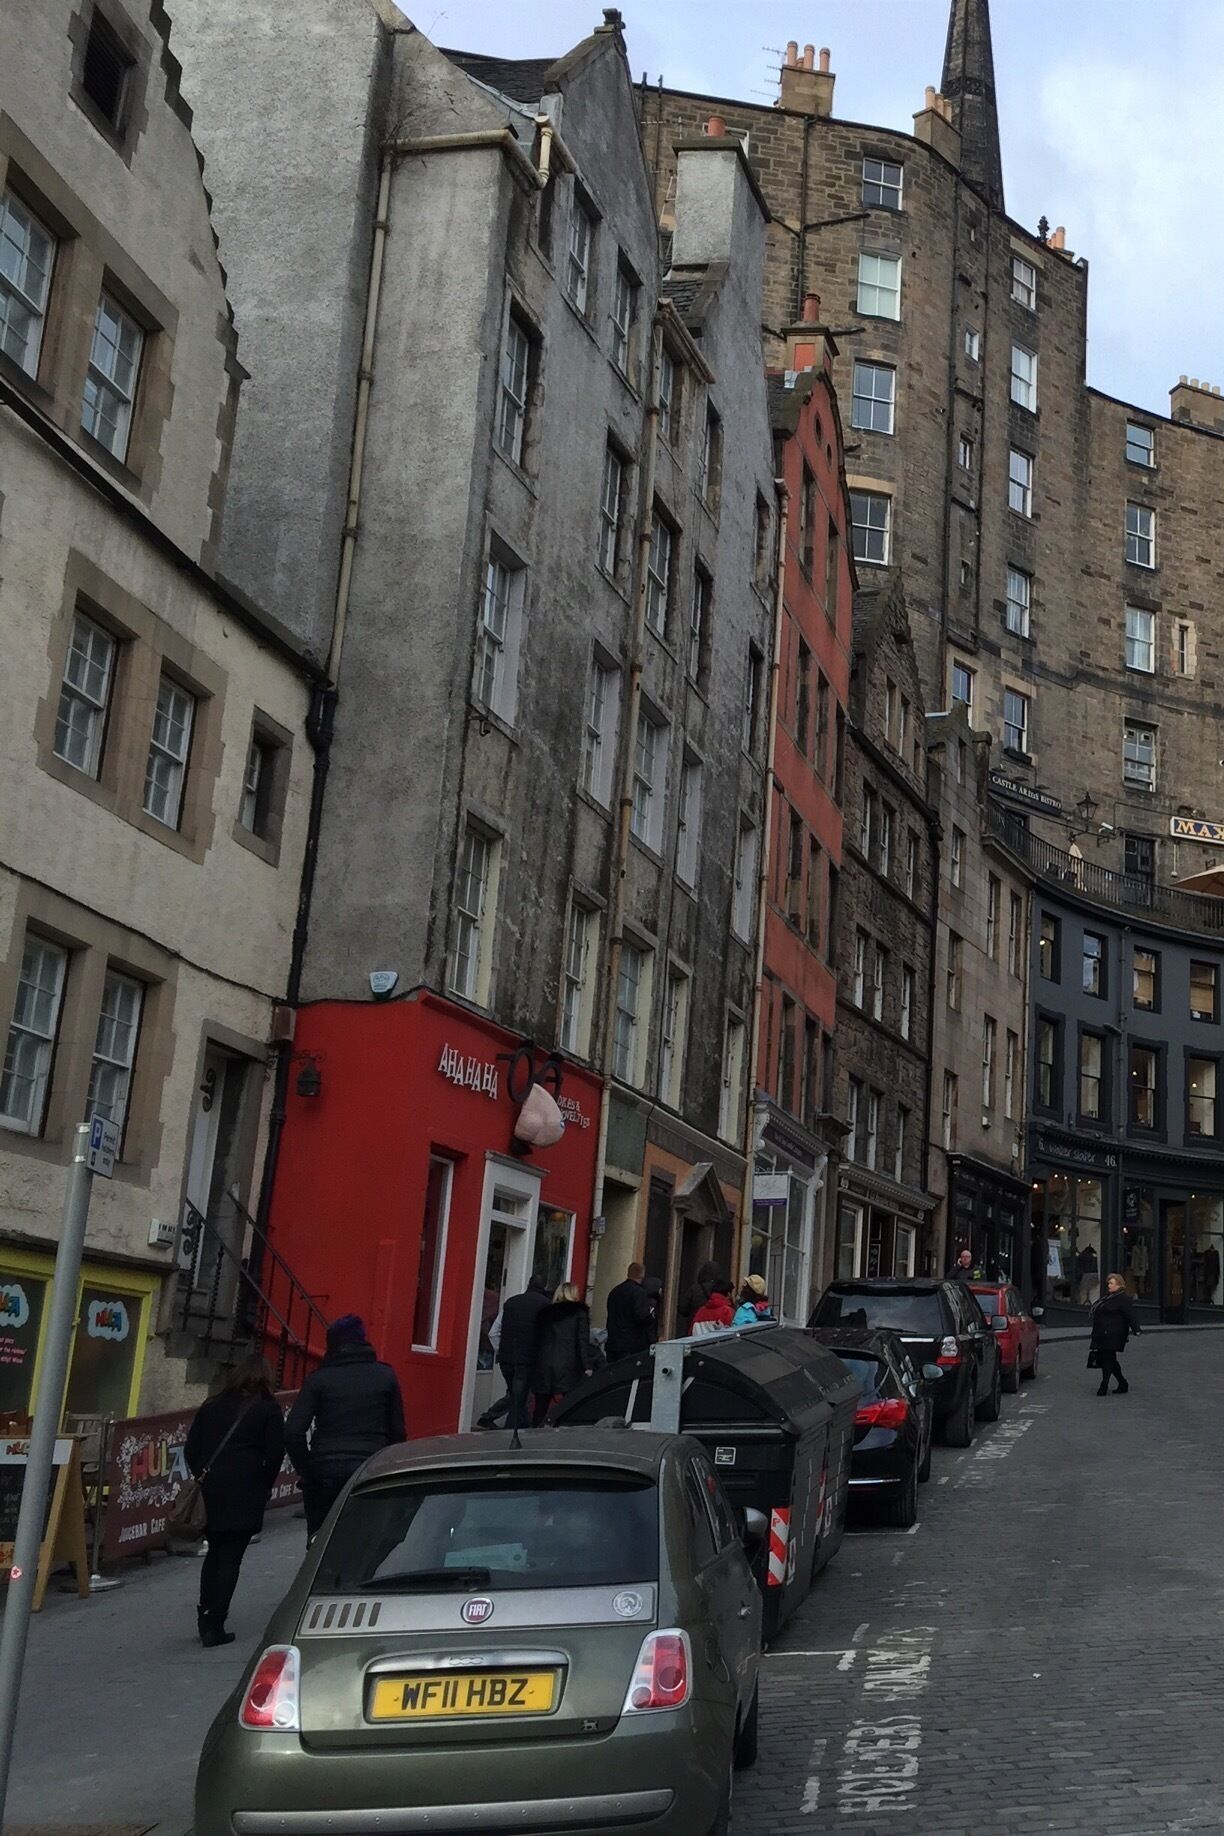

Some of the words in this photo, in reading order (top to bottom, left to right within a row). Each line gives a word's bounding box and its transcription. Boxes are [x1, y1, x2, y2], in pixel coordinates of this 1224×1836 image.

[992, 775, 1018, 792] CASTLE
[1040, 795, 1062, 809] BISTRO
[557, 1095, 576, 1111] OKES
[560, 1109, 590, 1129] OVELTIES
[132, 1440, 191, 1485] HULA
[118, 1521, 148, 1544] JUICEBAR
[150, 1517, 167, 1535] CAFE
[468, 1603, 488, 1617] FIAT
[400, 1681, 458, 1710] WF11
[467, 1678, 529, 1707] HBZ
